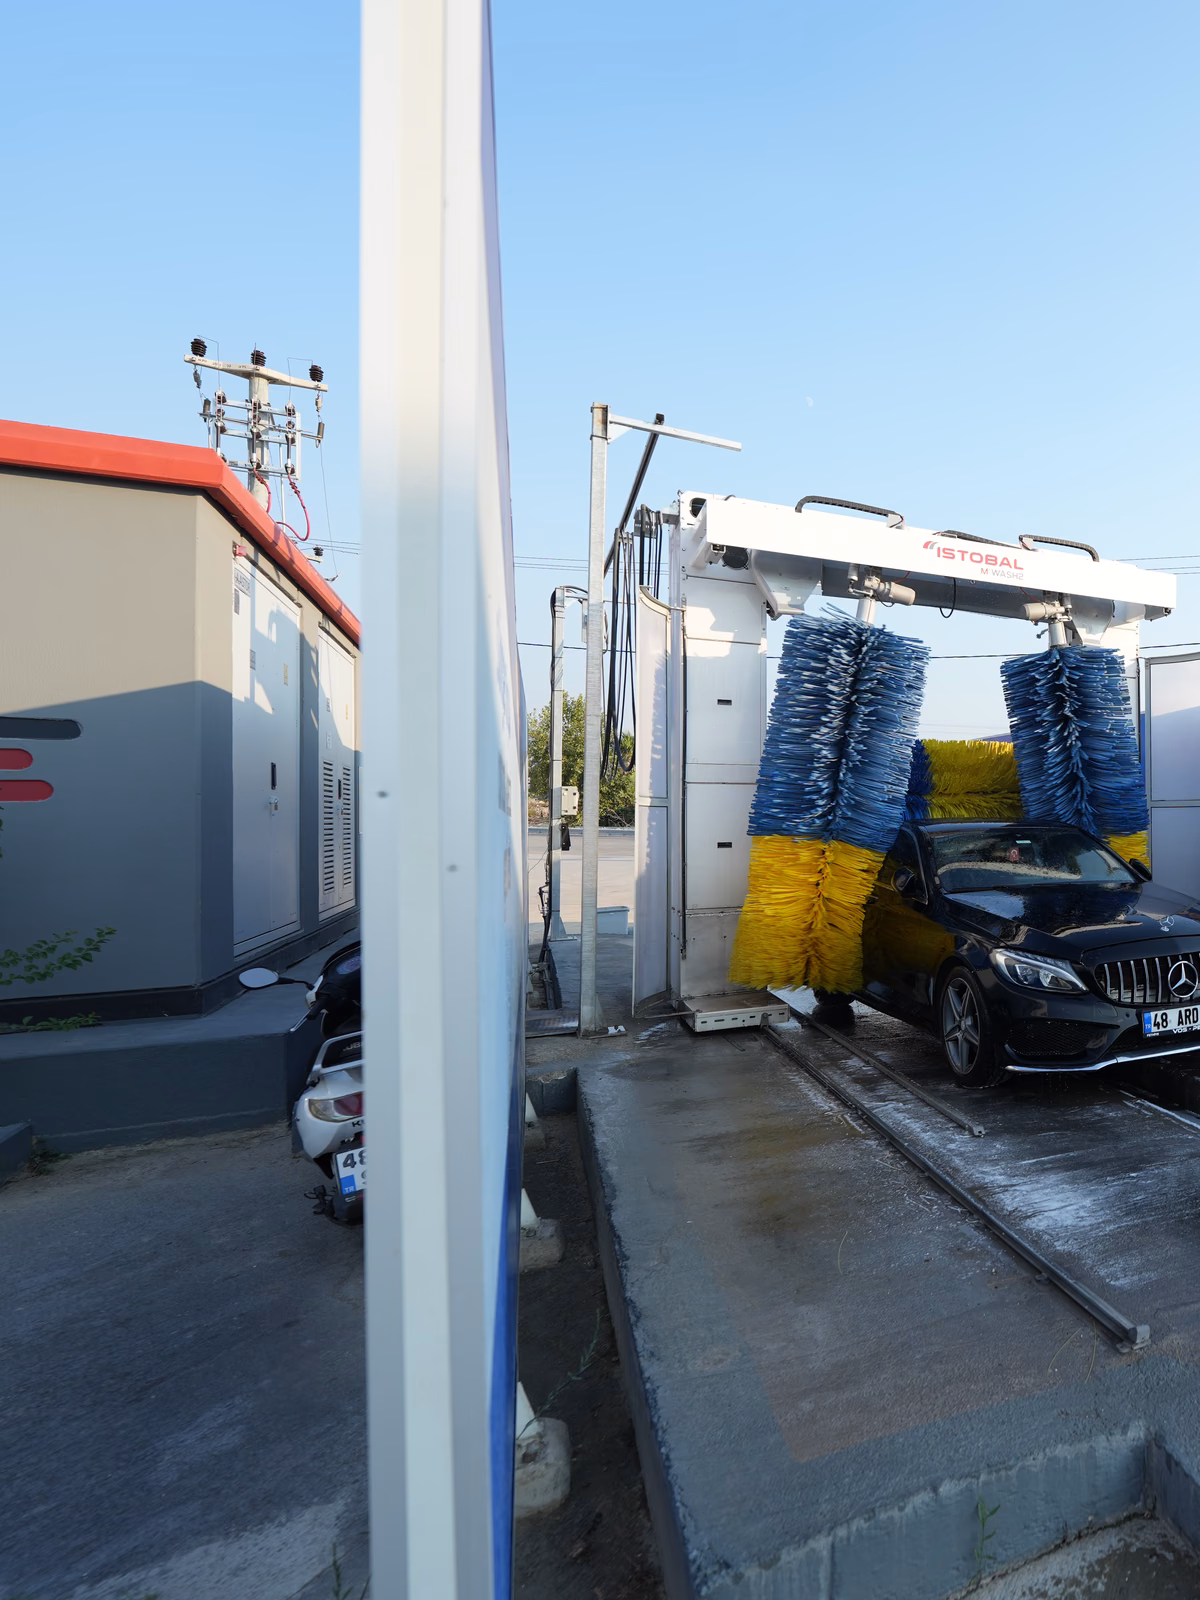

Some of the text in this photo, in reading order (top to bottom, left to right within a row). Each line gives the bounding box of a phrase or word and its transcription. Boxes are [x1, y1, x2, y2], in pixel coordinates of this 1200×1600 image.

[937, 547, 1024, 570] ISTOBAL
[1153, 1012, 1168, 1030] 48
[1177, 1007, 1199, 1026] ARD
[344, 1185, 355, 1194] TR
